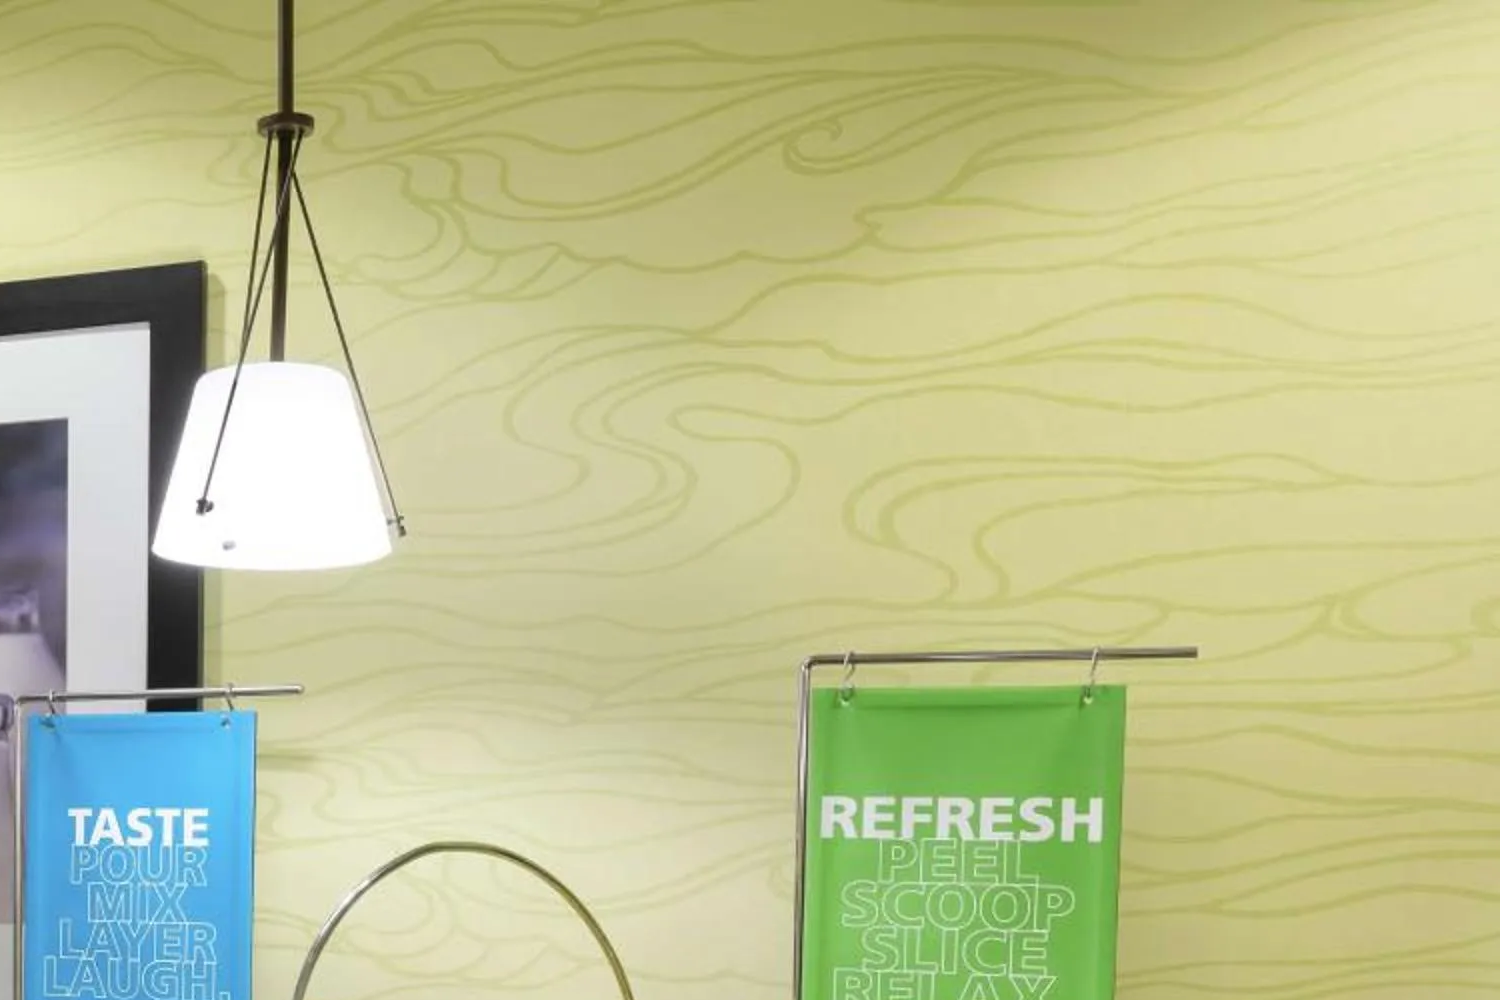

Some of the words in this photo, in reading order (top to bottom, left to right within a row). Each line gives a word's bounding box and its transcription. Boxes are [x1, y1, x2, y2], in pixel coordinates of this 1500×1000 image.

[67, 807, 210, 847] TASTE
[820, 795, 1104, 843] REFRESH
[70, 843, 208, 887] POUR
[877, 837, 1040, 885] PEEL
[87, 881, 189, 924] MIX
[841, 878, 1076, 932] SCOOP
[59, 918, 218, 965] LAYER
[861, 925, 1049, 977] SLICE
